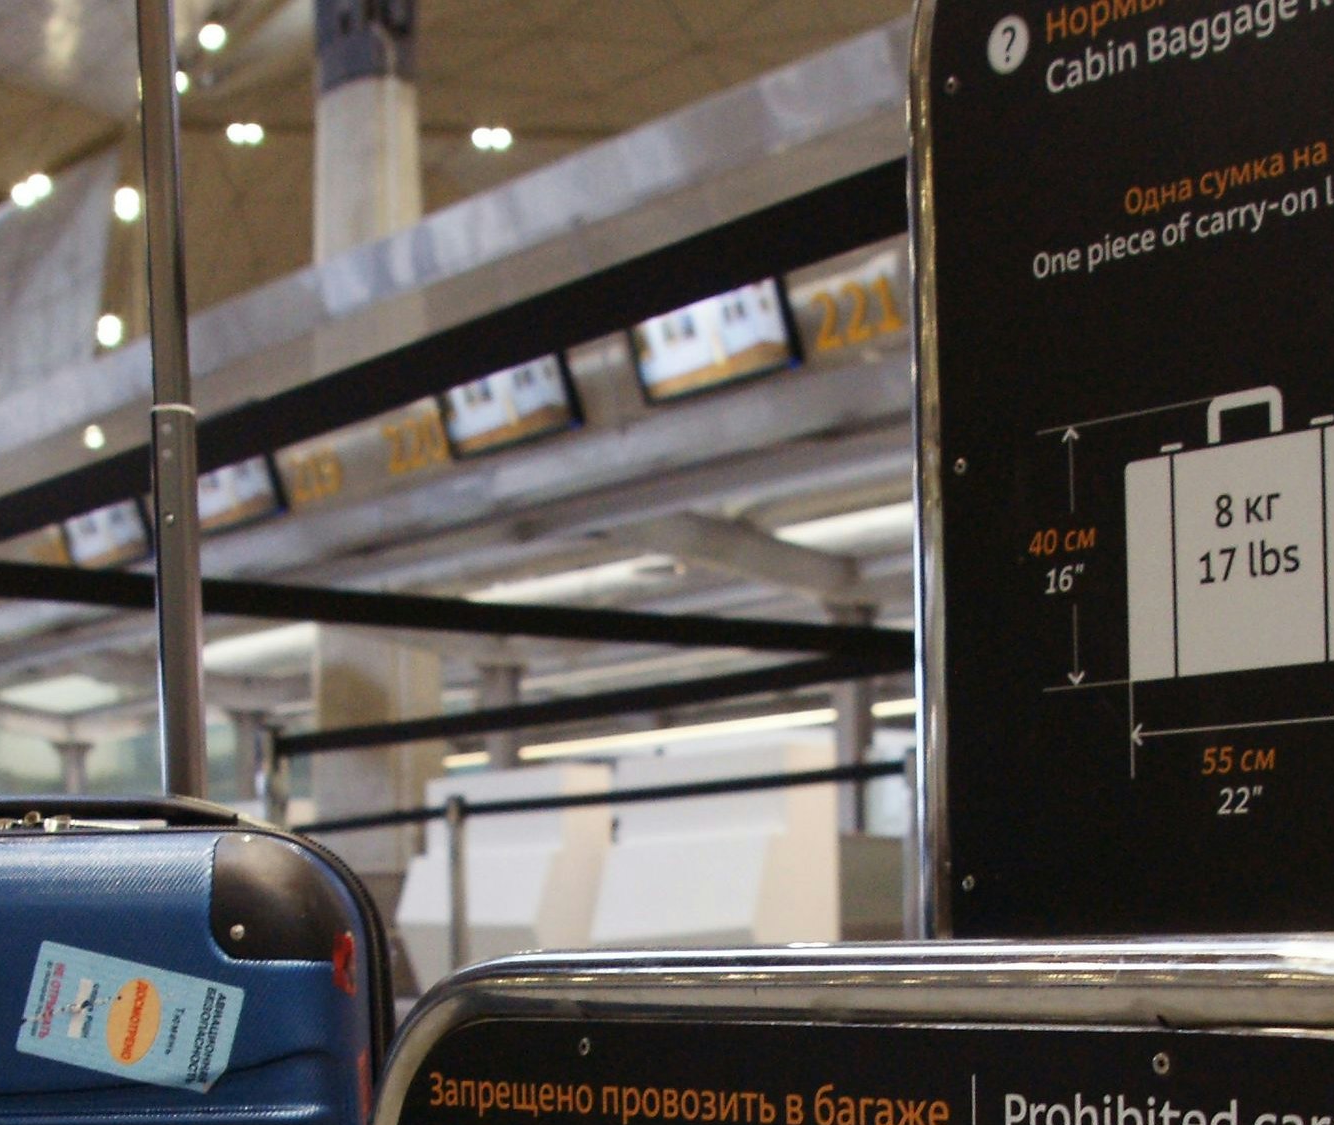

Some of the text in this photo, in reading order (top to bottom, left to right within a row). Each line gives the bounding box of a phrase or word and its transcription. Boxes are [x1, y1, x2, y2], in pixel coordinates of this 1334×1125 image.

[1046, 0, 1298, 93] Cabin Baggage
[1125, 178, 1192, 216] Одна
[1200, 153, 1284, 199] сумка
[1293, 139, 1327, 173] на
[1033, 246, 1080, 279] One
[1087, 226, 1154, 273] piece
[1162, 214, 1191, 246] of
[1196, 185, 1316, 239] carry-on
[811, 275, 904, 348] 221
[1215, 493, 1281, 528] 8 кг
[1029, 527, 1097, 556] 40 см
[1199, 540, 1301, 584] 17 lbs
[1201, 747, 1276, 775] 55 см
[119, 980, 149, 1061] ДОСМОТРЕНО
[429, 1072, 593, 1117] Запрещено
